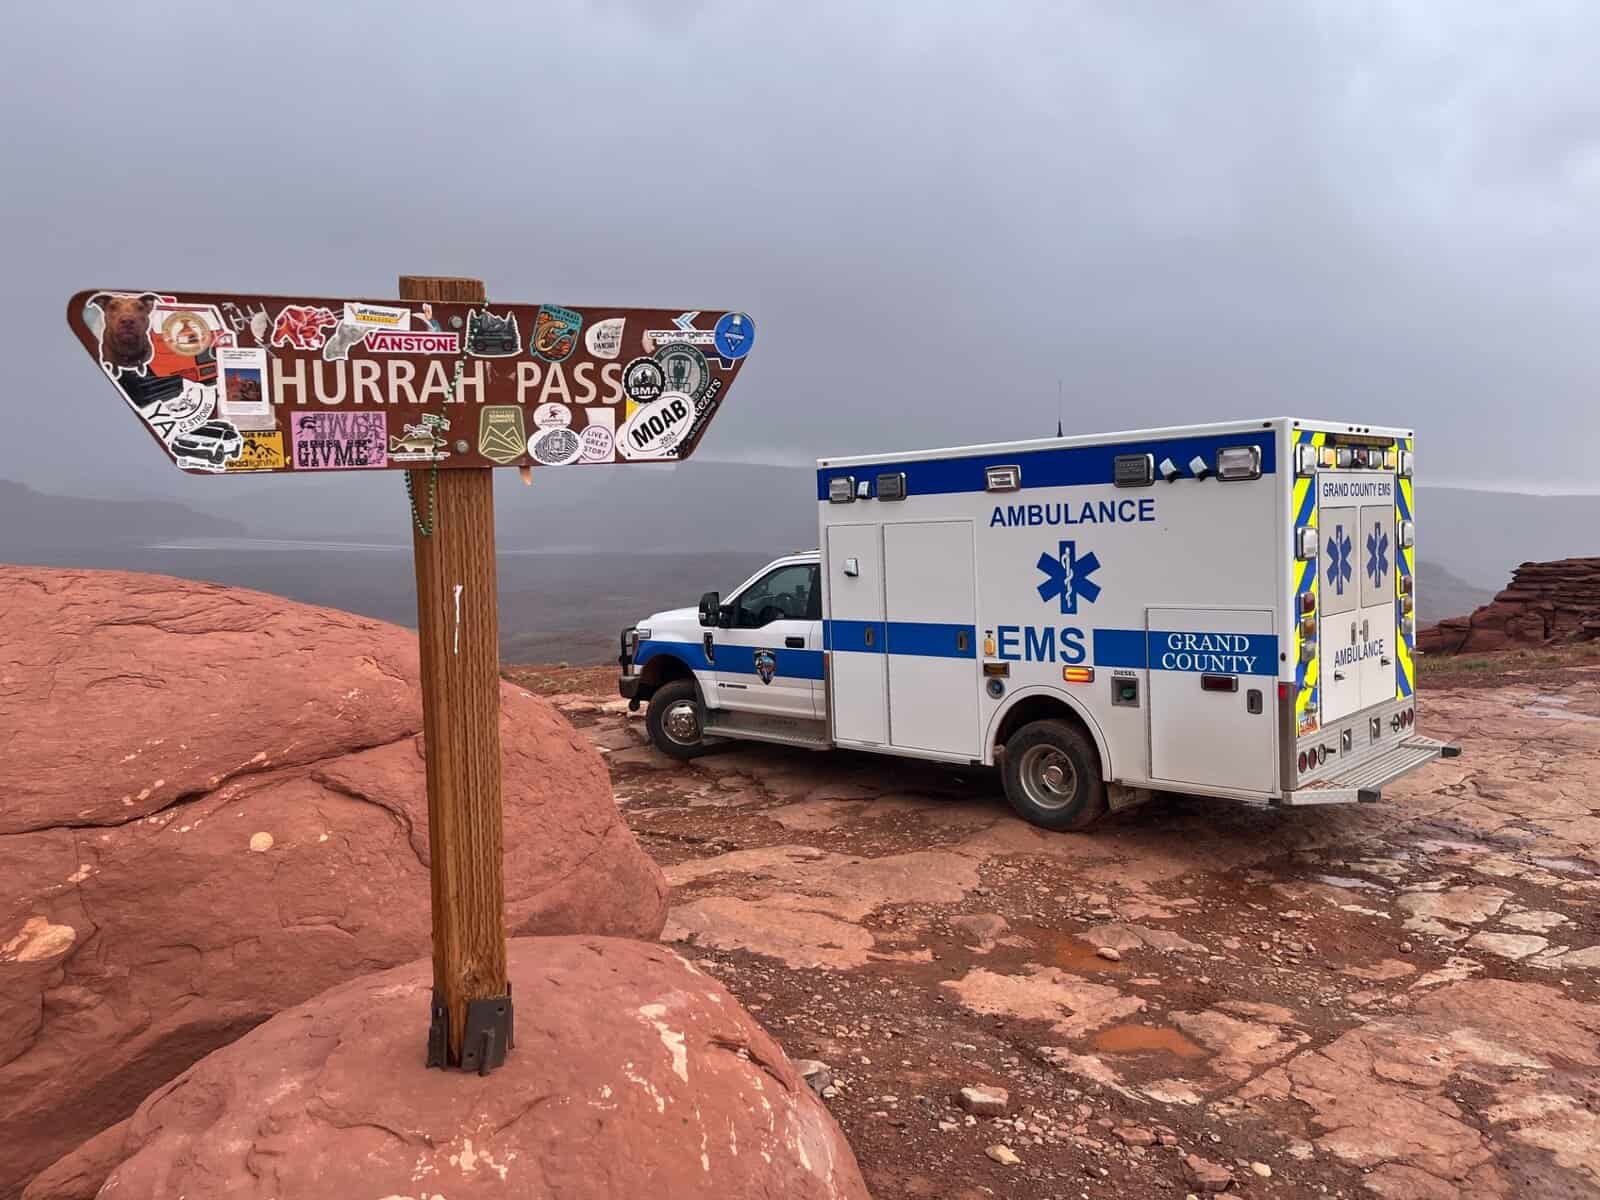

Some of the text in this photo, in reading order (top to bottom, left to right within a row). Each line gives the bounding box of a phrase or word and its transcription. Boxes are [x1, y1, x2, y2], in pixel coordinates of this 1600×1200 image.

[365, 332, 457, 351] VANSTONE
[649, 331, 715, 339] convergenc
[272, 358, 623, 404] HURRAH PASS
[631, 386, 660, 396] BMA
[695, 378, 721, 416] eezers
[186, 402, 213, 430] STRONG
[631, 399, 688, 448] MOAB
[585, 439, 609, 447] GREAT
[587, 430, 603, 439] LIVE
[584, 445, 606, 456] STORY
[1323, 482, 1391, 497] GRAND COUNTY EMS
[990, 499, 1155, 527] AMBULANCE
[998, 625, 1087, 664] EMS
[1167, 633, 1250, 653] GRAND
[1334, 639, 1384, 667] AMBULANCE
[1162, 652, 1257, 672] COUNTY
